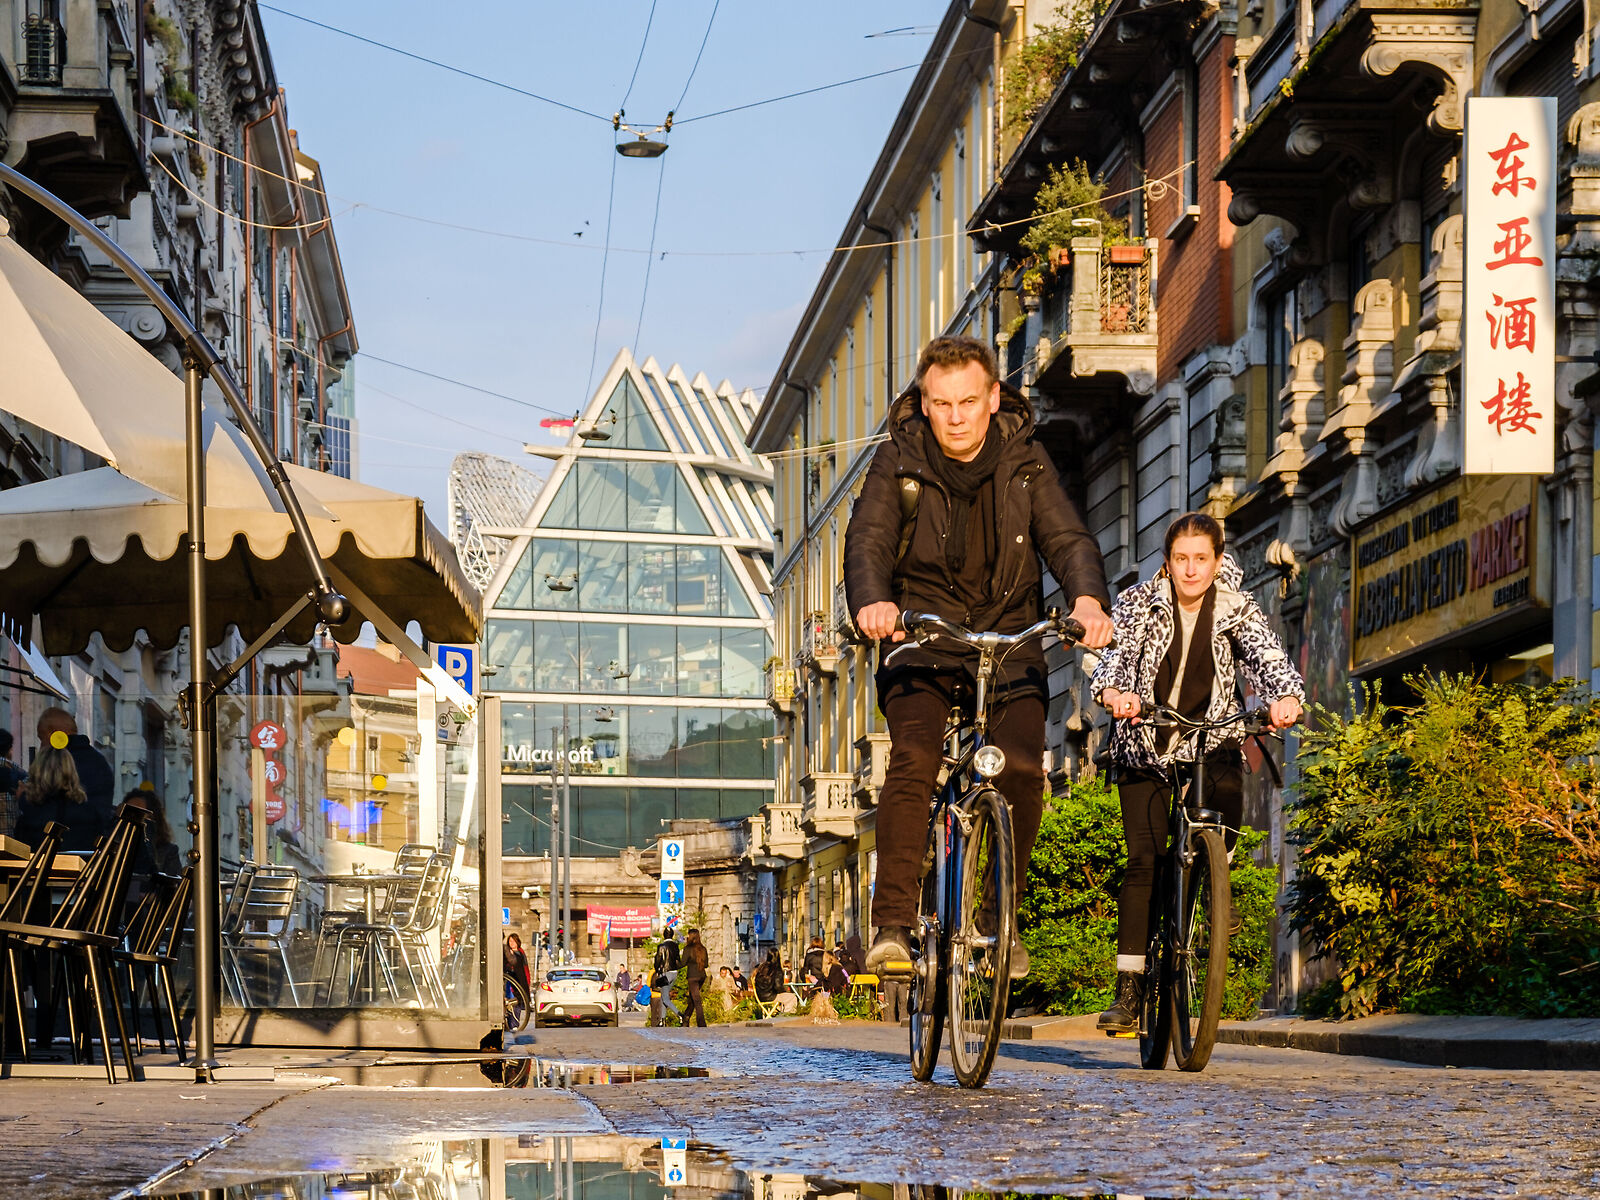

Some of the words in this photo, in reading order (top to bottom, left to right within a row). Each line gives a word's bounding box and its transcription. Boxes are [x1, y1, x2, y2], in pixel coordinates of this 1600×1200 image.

[1480, 131, 1544, 437] 东亚酒楼
[1356, 537, 1467, 640] ABBIGLIAMENTO
[1469, 503, 1532, 592] MARKET
[446, 650, 468, 678] P
[507, 744, 594, 764] Microsoft
